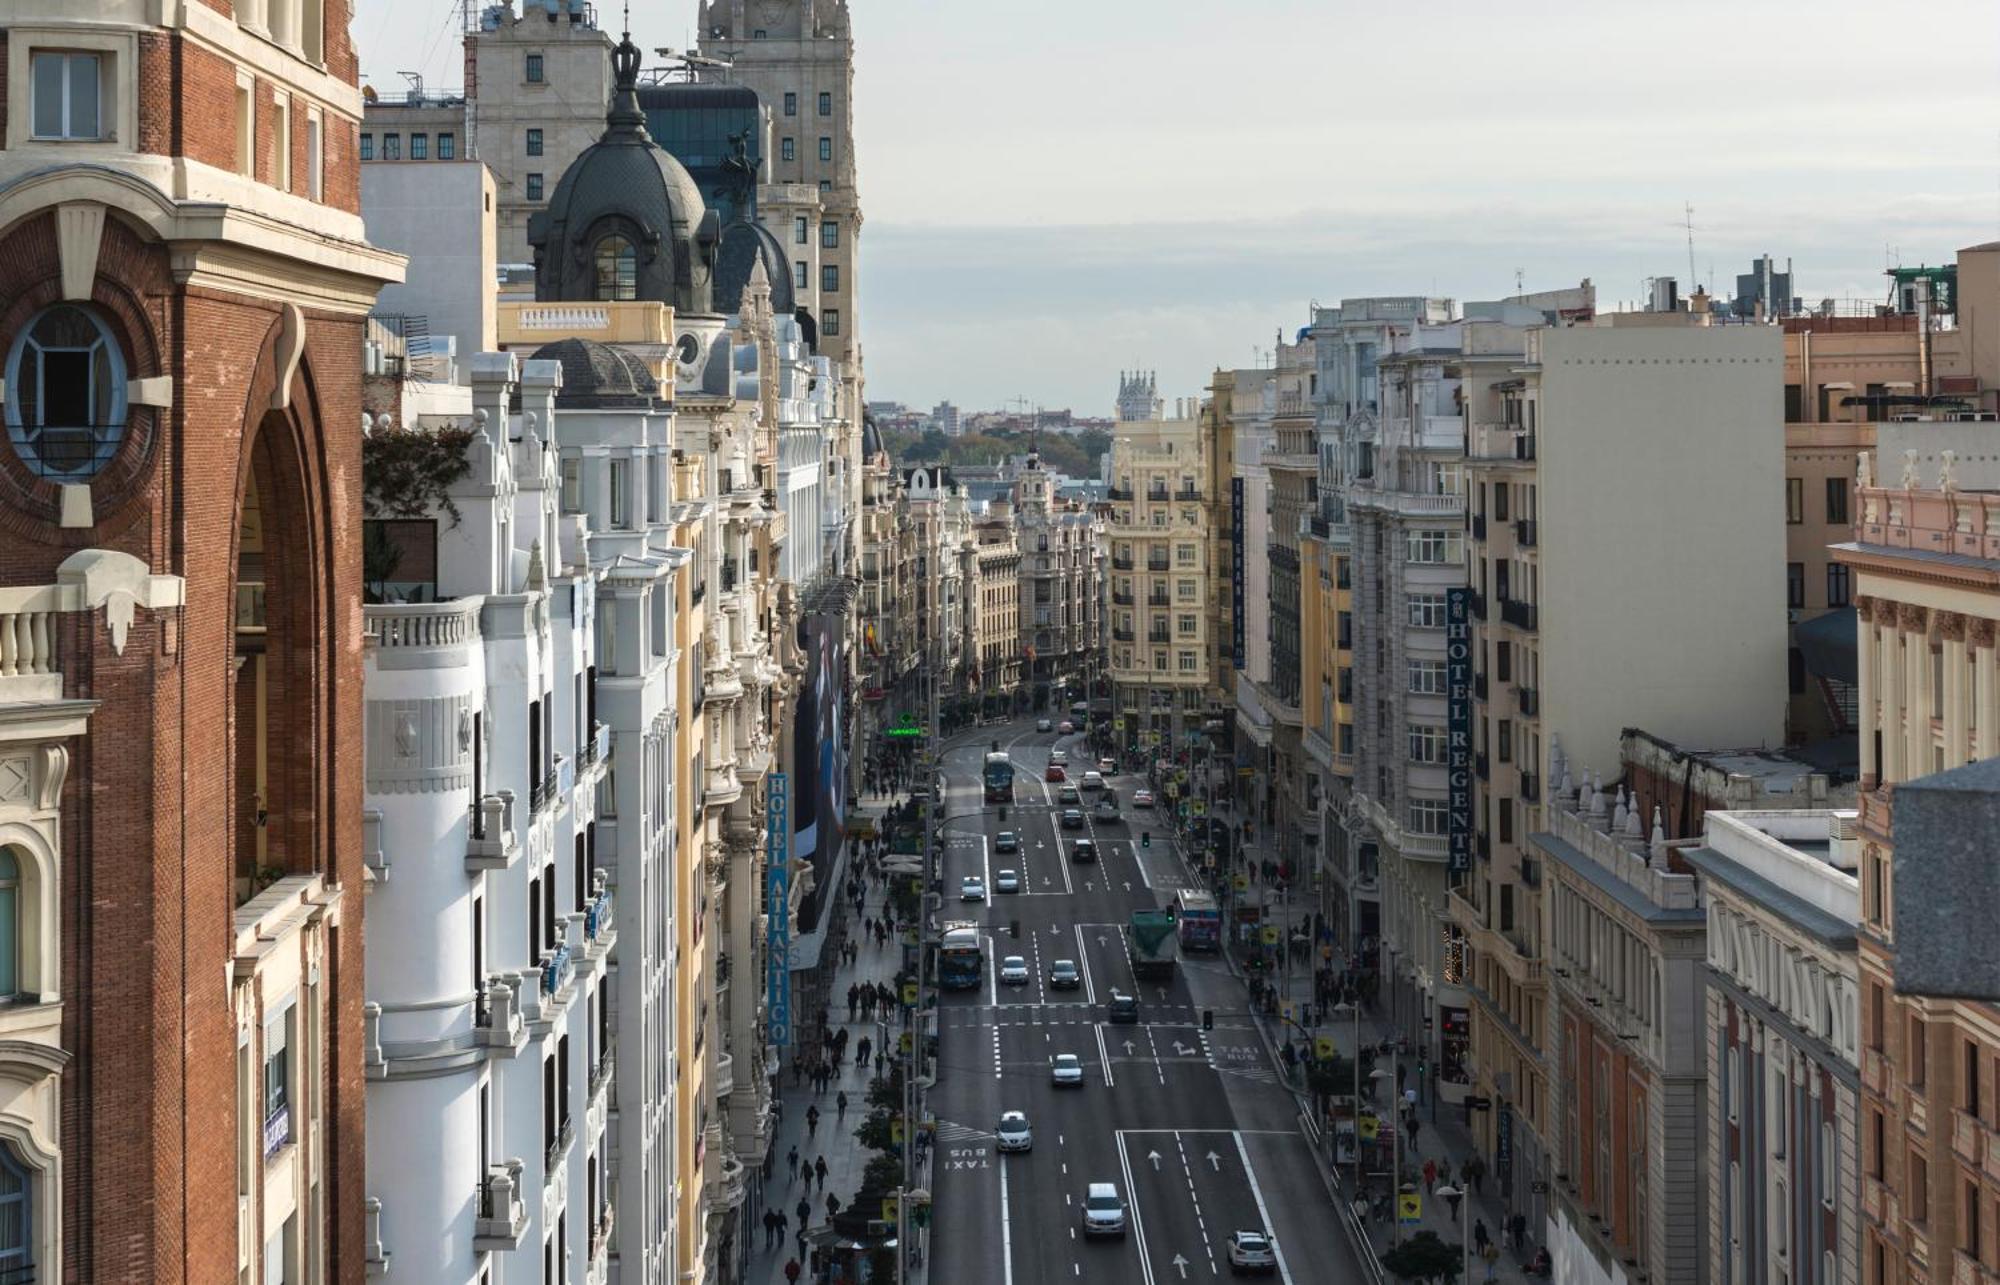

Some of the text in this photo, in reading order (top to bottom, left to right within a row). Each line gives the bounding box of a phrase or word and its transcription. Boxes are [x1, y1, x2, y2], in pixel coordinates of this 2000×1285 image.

[1448, 623, 1469, 870] HOTEL REGENTE
[770, 779, 787, 1039] HOTEL ATLANTICO
[945, 1160, 990, 1170] TAXI
[949, 1149, 986, 1158] BUS
